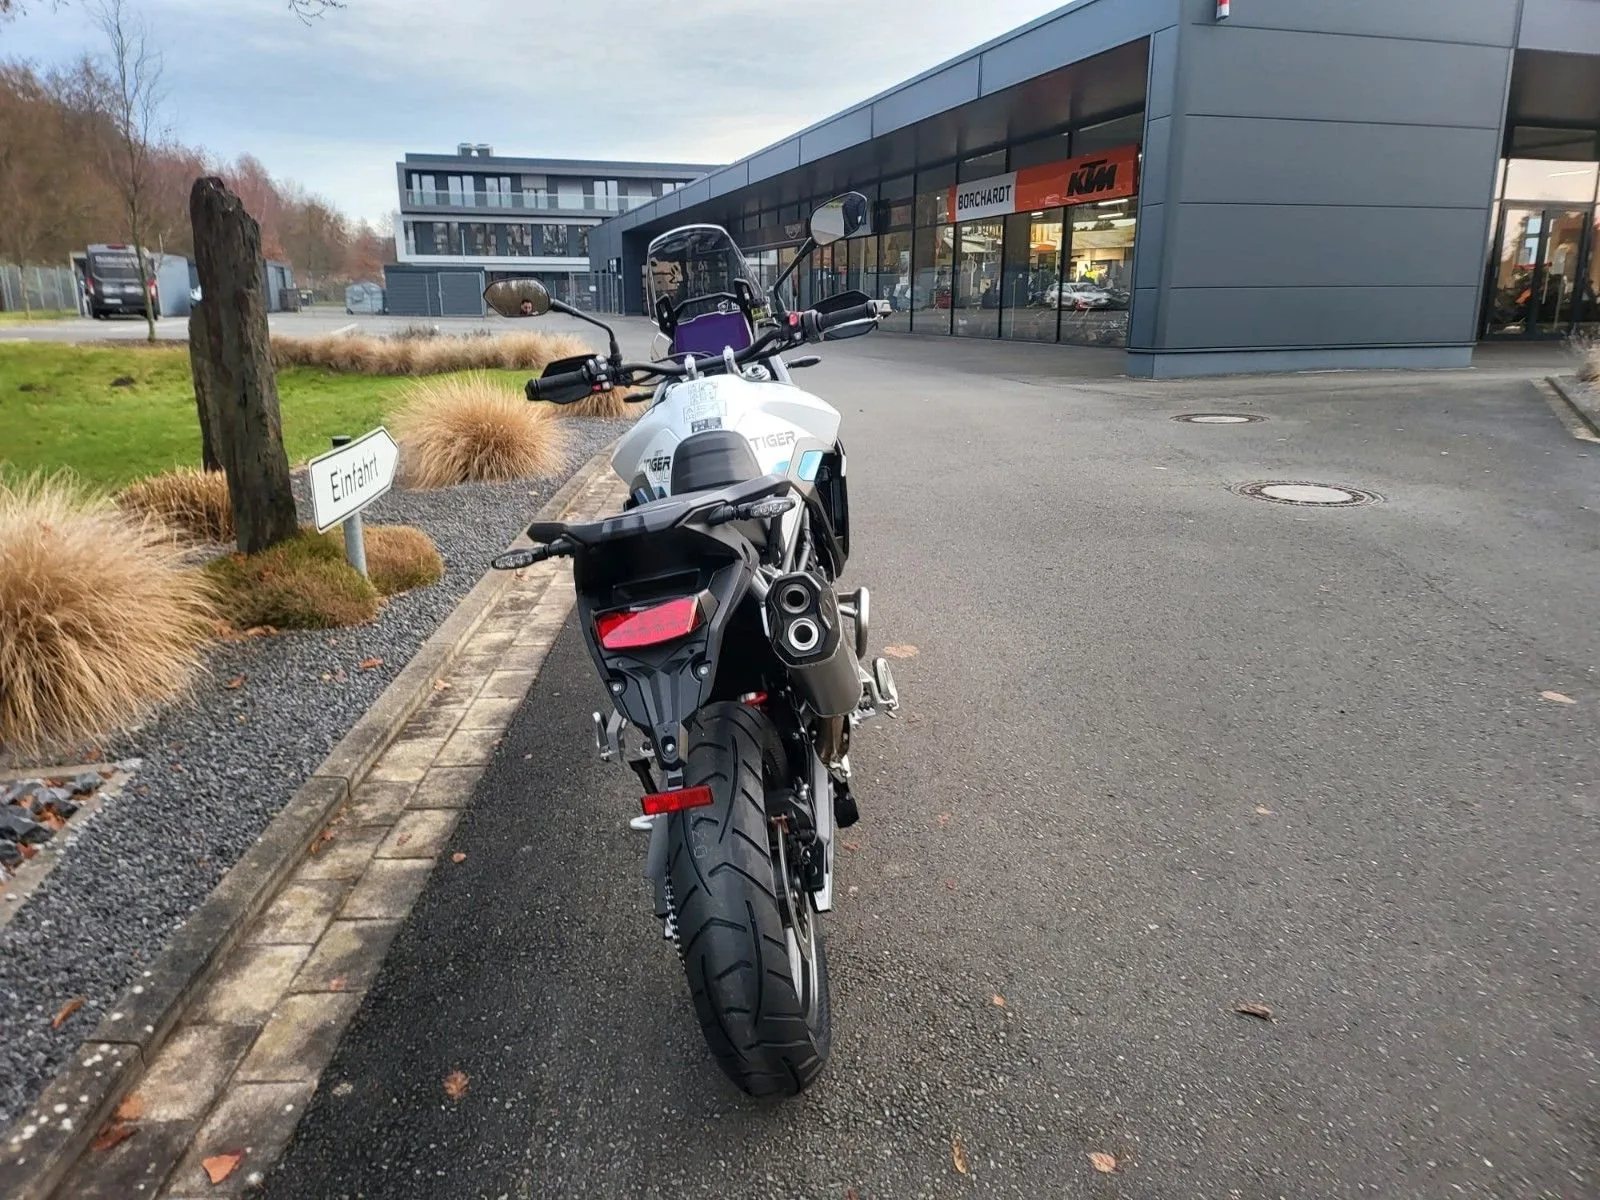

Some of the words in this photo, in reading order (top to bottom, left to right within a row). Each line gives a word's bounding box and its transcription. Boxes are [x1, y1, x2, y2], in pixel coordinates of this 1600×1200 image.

[1067, 159, 1117, 197] KTM
[957, 184, 1012, 211] BORCHARDT
[749, 430, 796, 451] TIGER
[330, 453, 379, 503] Einfahrt
